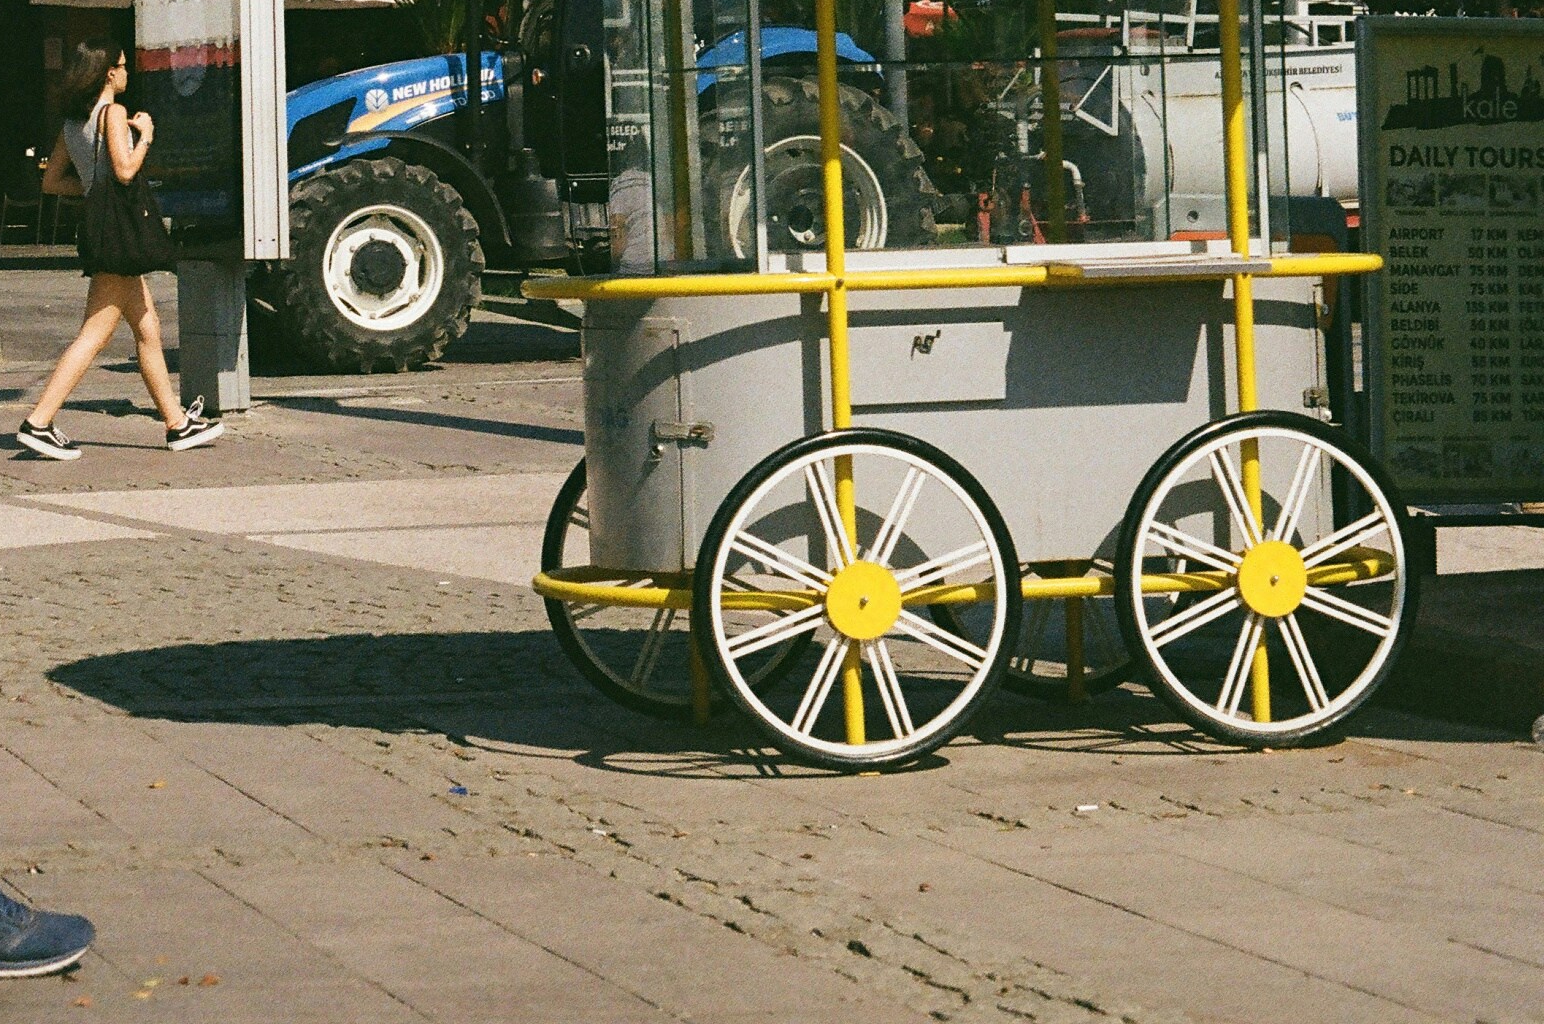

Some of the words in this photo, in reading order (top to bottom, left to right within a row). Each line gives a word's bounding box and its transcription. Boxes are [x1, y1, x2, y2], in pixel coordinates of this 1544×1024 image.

[1299, 65, 1343, 75] BELEDİYESİ
[392, 83, 428, 101] NEW
[1462, 83, 1518, 118] kale
[1390, 145, 1459, 167] DAILY
[1389, 228, 1444, 240] AIRPORT
[1487, 228, 1507, 240] KM
[1389, 246, 1428, 258] BELEK
[1487, 247, 1507, 258] KM
[1469, 265, 1484, 276] 75
[1487, 265, 1508, 276] KM
[1470, 283, 1485, 295] 75
[1488, 283, 1508, 295] KM
[1390, 301, 1441, 313] ALANYA
[1488, 301, 1509, 313] KM
[1489, 319, 1509, 331] KM
[1391, 334, 1444, 349] GÖYNÜK
[1470, 337, 1486, 350] 40
[1489, 337, 1510, 350] KM
[1489, 356, 1510, 368] KM
[1490, 373, 1511, 386] KM
[1491, 392, 1511, 404] KM
[1491, 410, 1512, 422] KM
